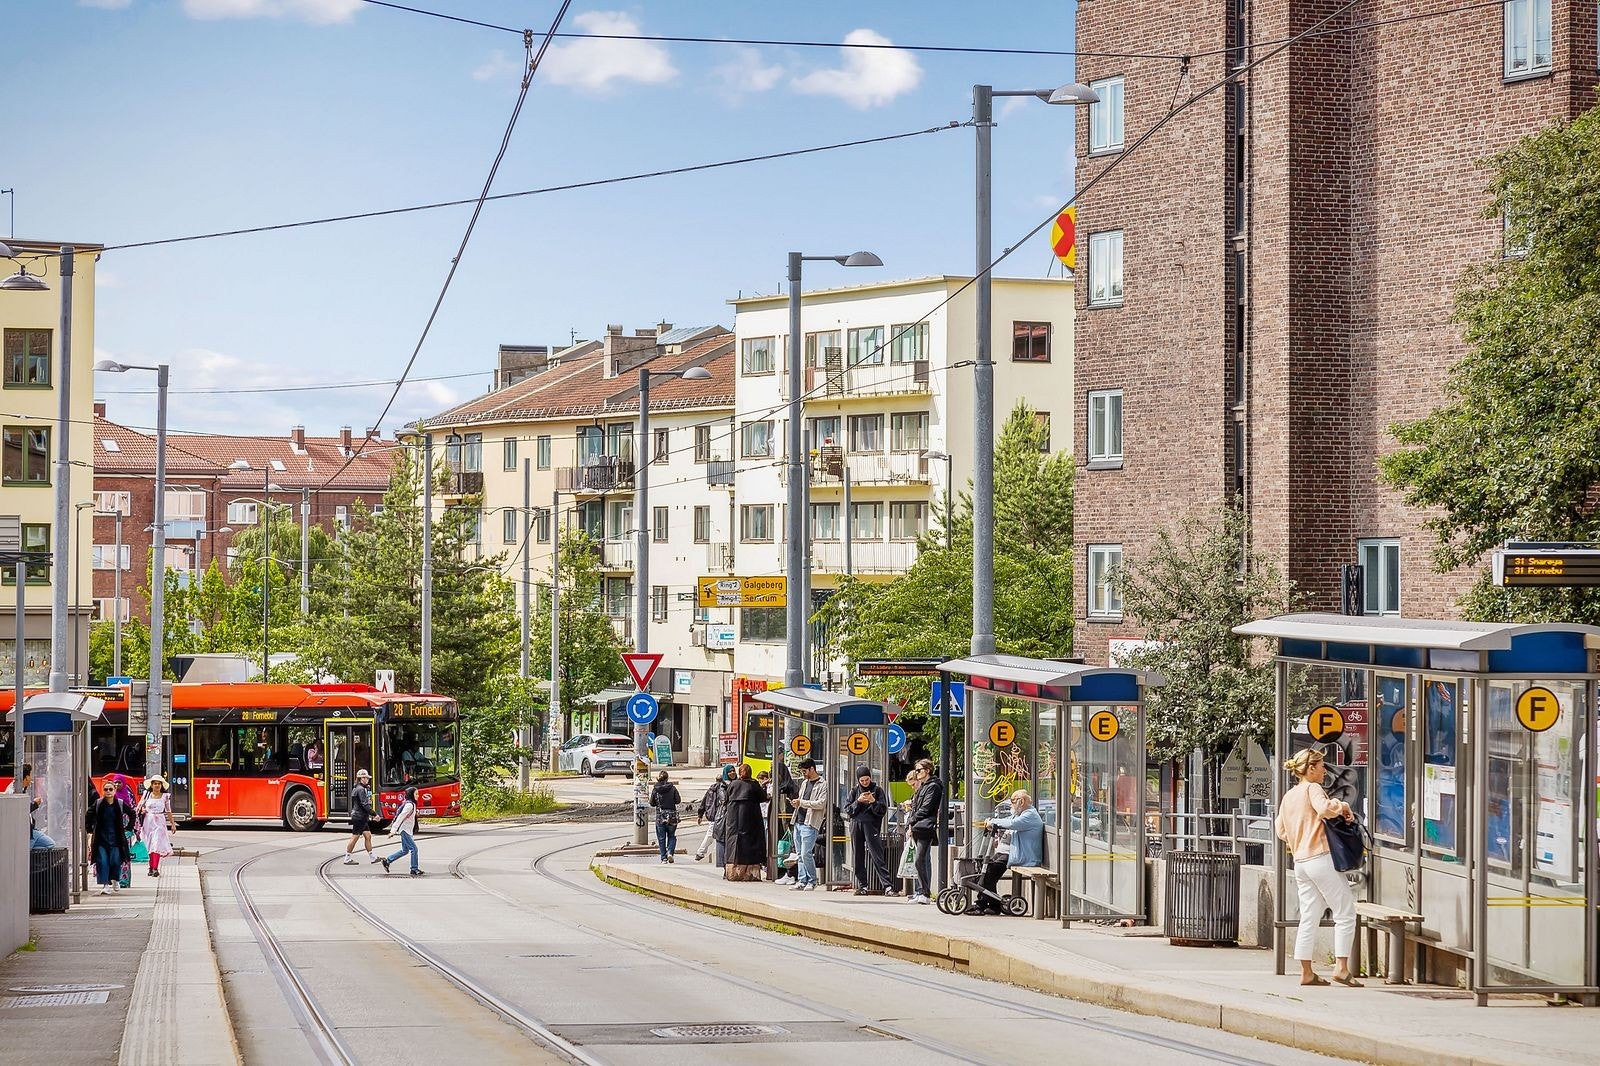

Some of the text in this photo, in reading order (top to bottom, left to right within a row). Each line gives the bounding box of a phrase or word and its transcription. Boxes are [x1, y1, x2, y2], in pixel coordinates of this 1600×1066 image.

[1514, 567, 1563, 575] 31 Fornebu
[744, 581, 783, 591] Galgeberg
[744, 680, 764, 690] EXTRA
[241, 711, 275, 720] 28 Fornebu
[393, 703, 443, 716] 28 Fornebu
[1530, 696, 1547, 722] F
[1098, 717, 1110, 735] E
[1319, 713, 1334, 735] F
[997, 725, 1008, 742] E
[797, 739, 806, 752] E
[854, 737, 863, 750] E
